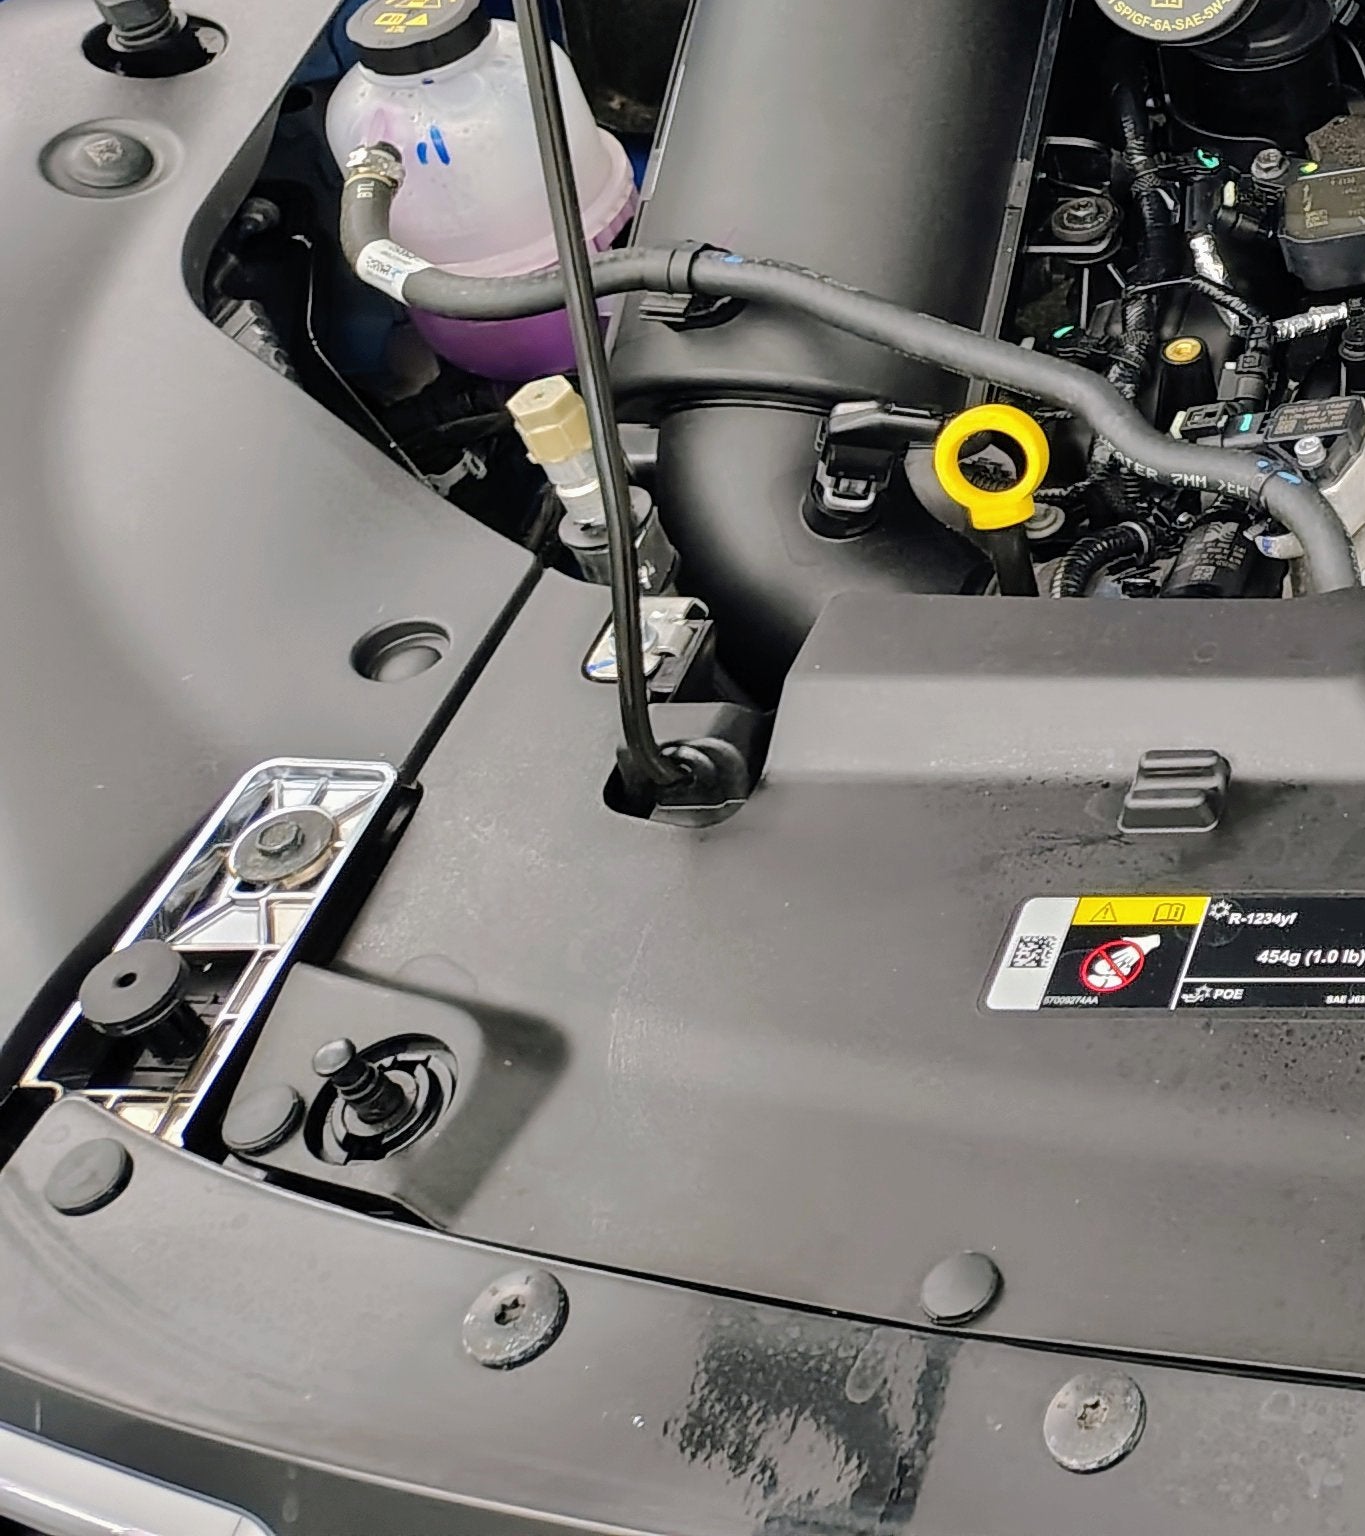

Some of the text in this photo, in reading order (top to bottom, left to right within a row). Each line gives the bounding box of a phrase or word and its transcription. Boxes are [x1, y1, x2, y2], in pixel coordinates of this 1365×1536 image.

[1170, 473, 1207, 488] 7MM
[1228, 912, 1298, 927] R-1234yf
[1256, 950, 1301, 967] 454g
[1304, 948, 1338, 967] (1.0
[1213, 988, 1244, 1000] POE
[1326, 995, 1347, 1004] SAE
